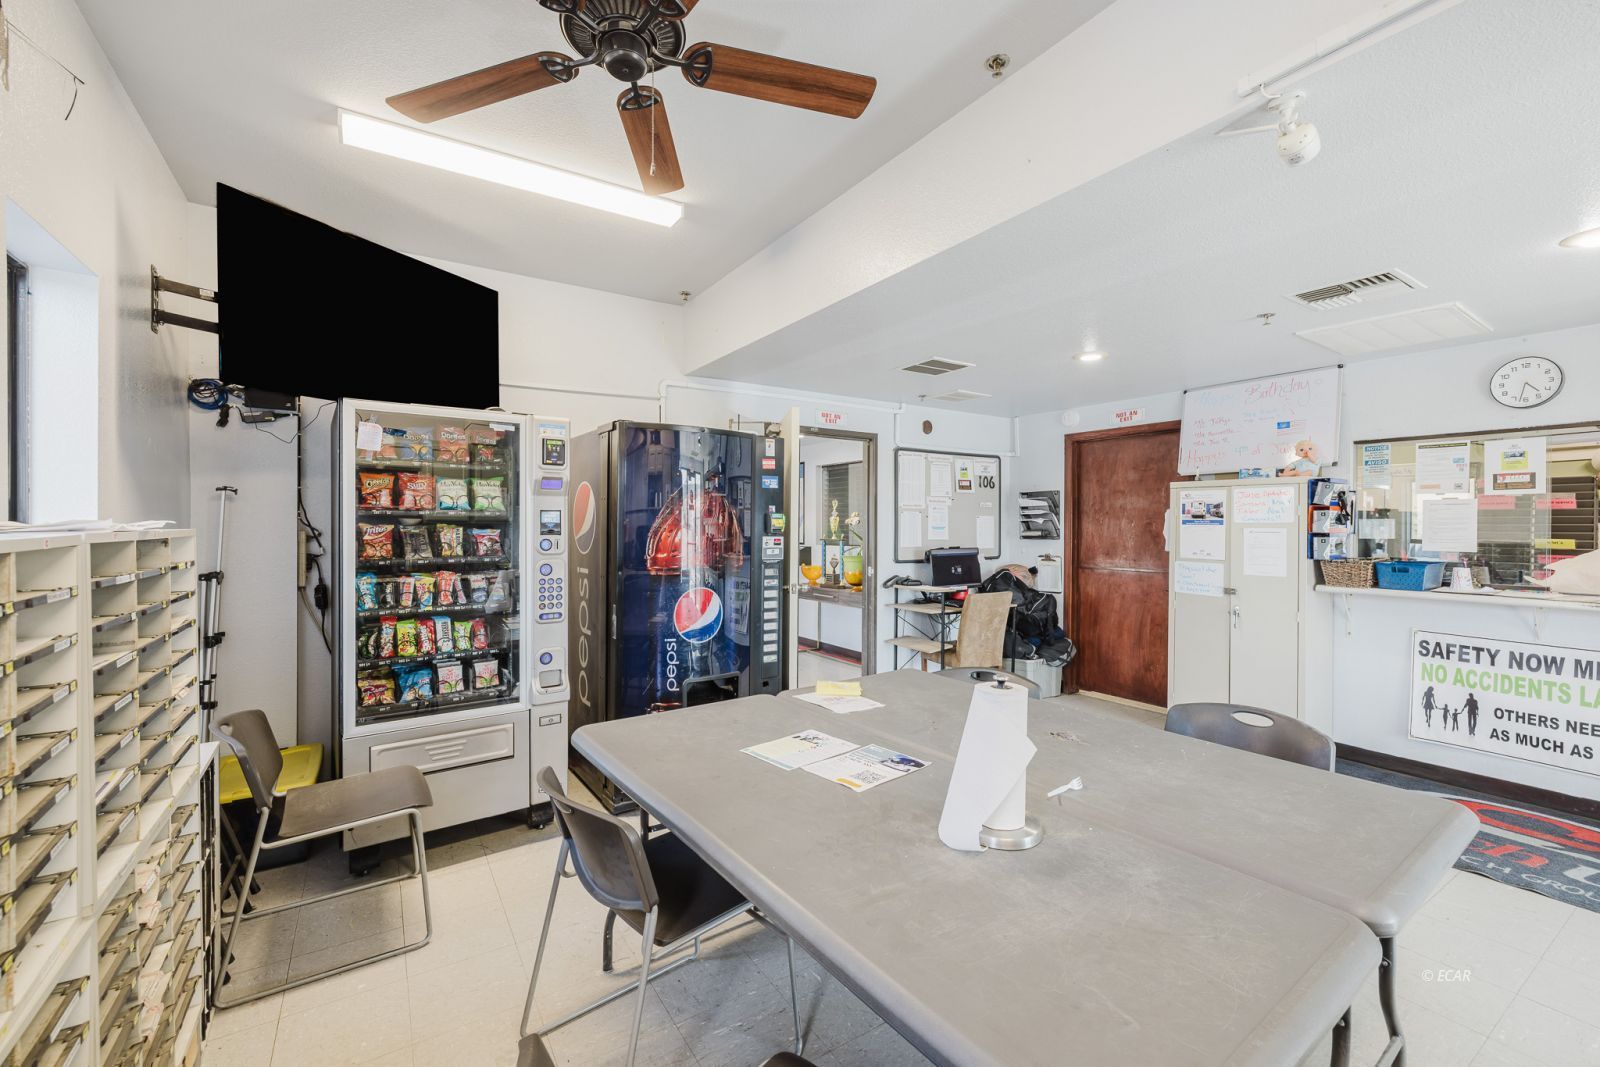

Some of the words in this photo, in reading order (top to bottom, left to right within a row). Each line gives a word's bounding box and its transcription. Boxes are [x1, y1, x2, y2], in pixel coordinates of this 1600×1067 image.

[978, 475, 995, 489] 106
[577, 567, 592, 708] pepsi
[664, 638, 680, 692] pepsi
[1418, 639, 1501, 667] SAFETY
[1508, 651, 1566, 676] NOW
[1421, 662, 1448, 684] NO
[1452, 667, 1572, 705] ACCIDENTS
[1494, 707, 1560, 730] OTHERS
[1489, 728, 1511, 742] AS
[1515, 733, 1565, 754] MUCH
[1570, 744, 1594, 759] AS
